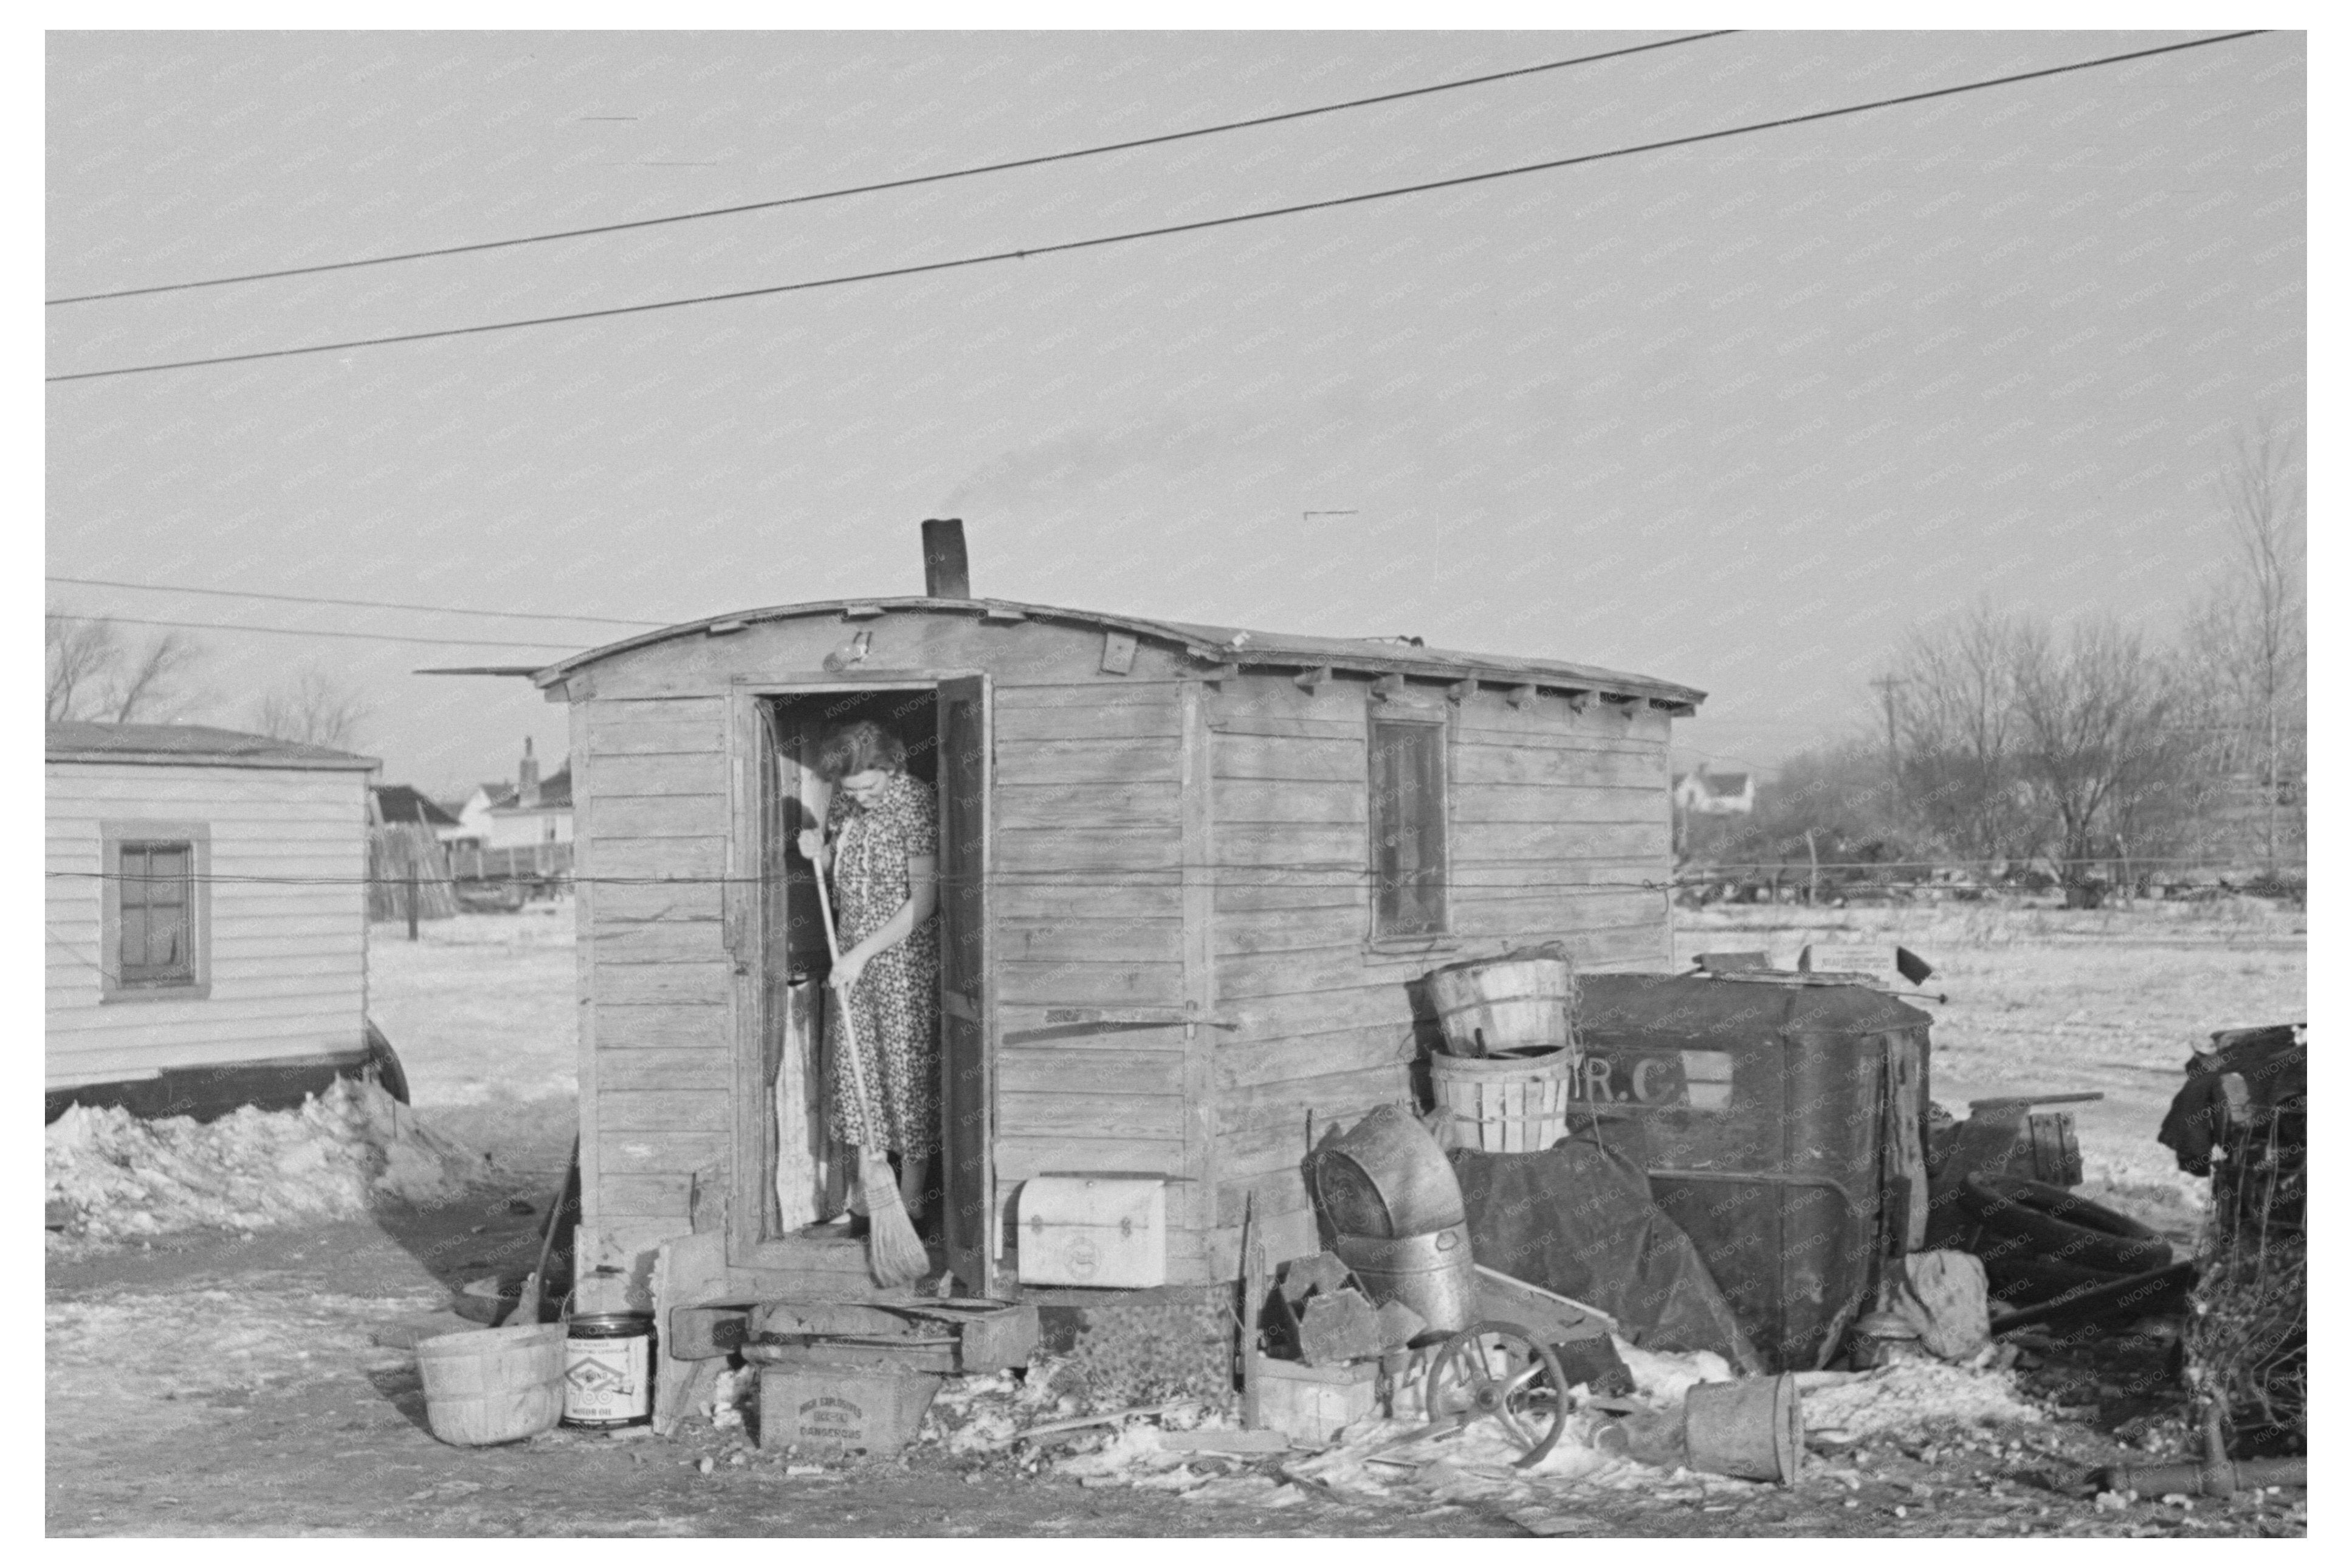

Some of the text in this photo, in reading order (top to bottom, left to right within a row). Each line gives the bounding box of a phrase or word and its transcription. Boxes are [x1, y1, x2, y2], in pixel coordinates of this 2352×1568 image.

[599, 1408, 612, 1416] OIL
[820, 1397, 862, 1419] EXPLOSIVES
[799, 1426, 862, 1440] DANGEROUS
